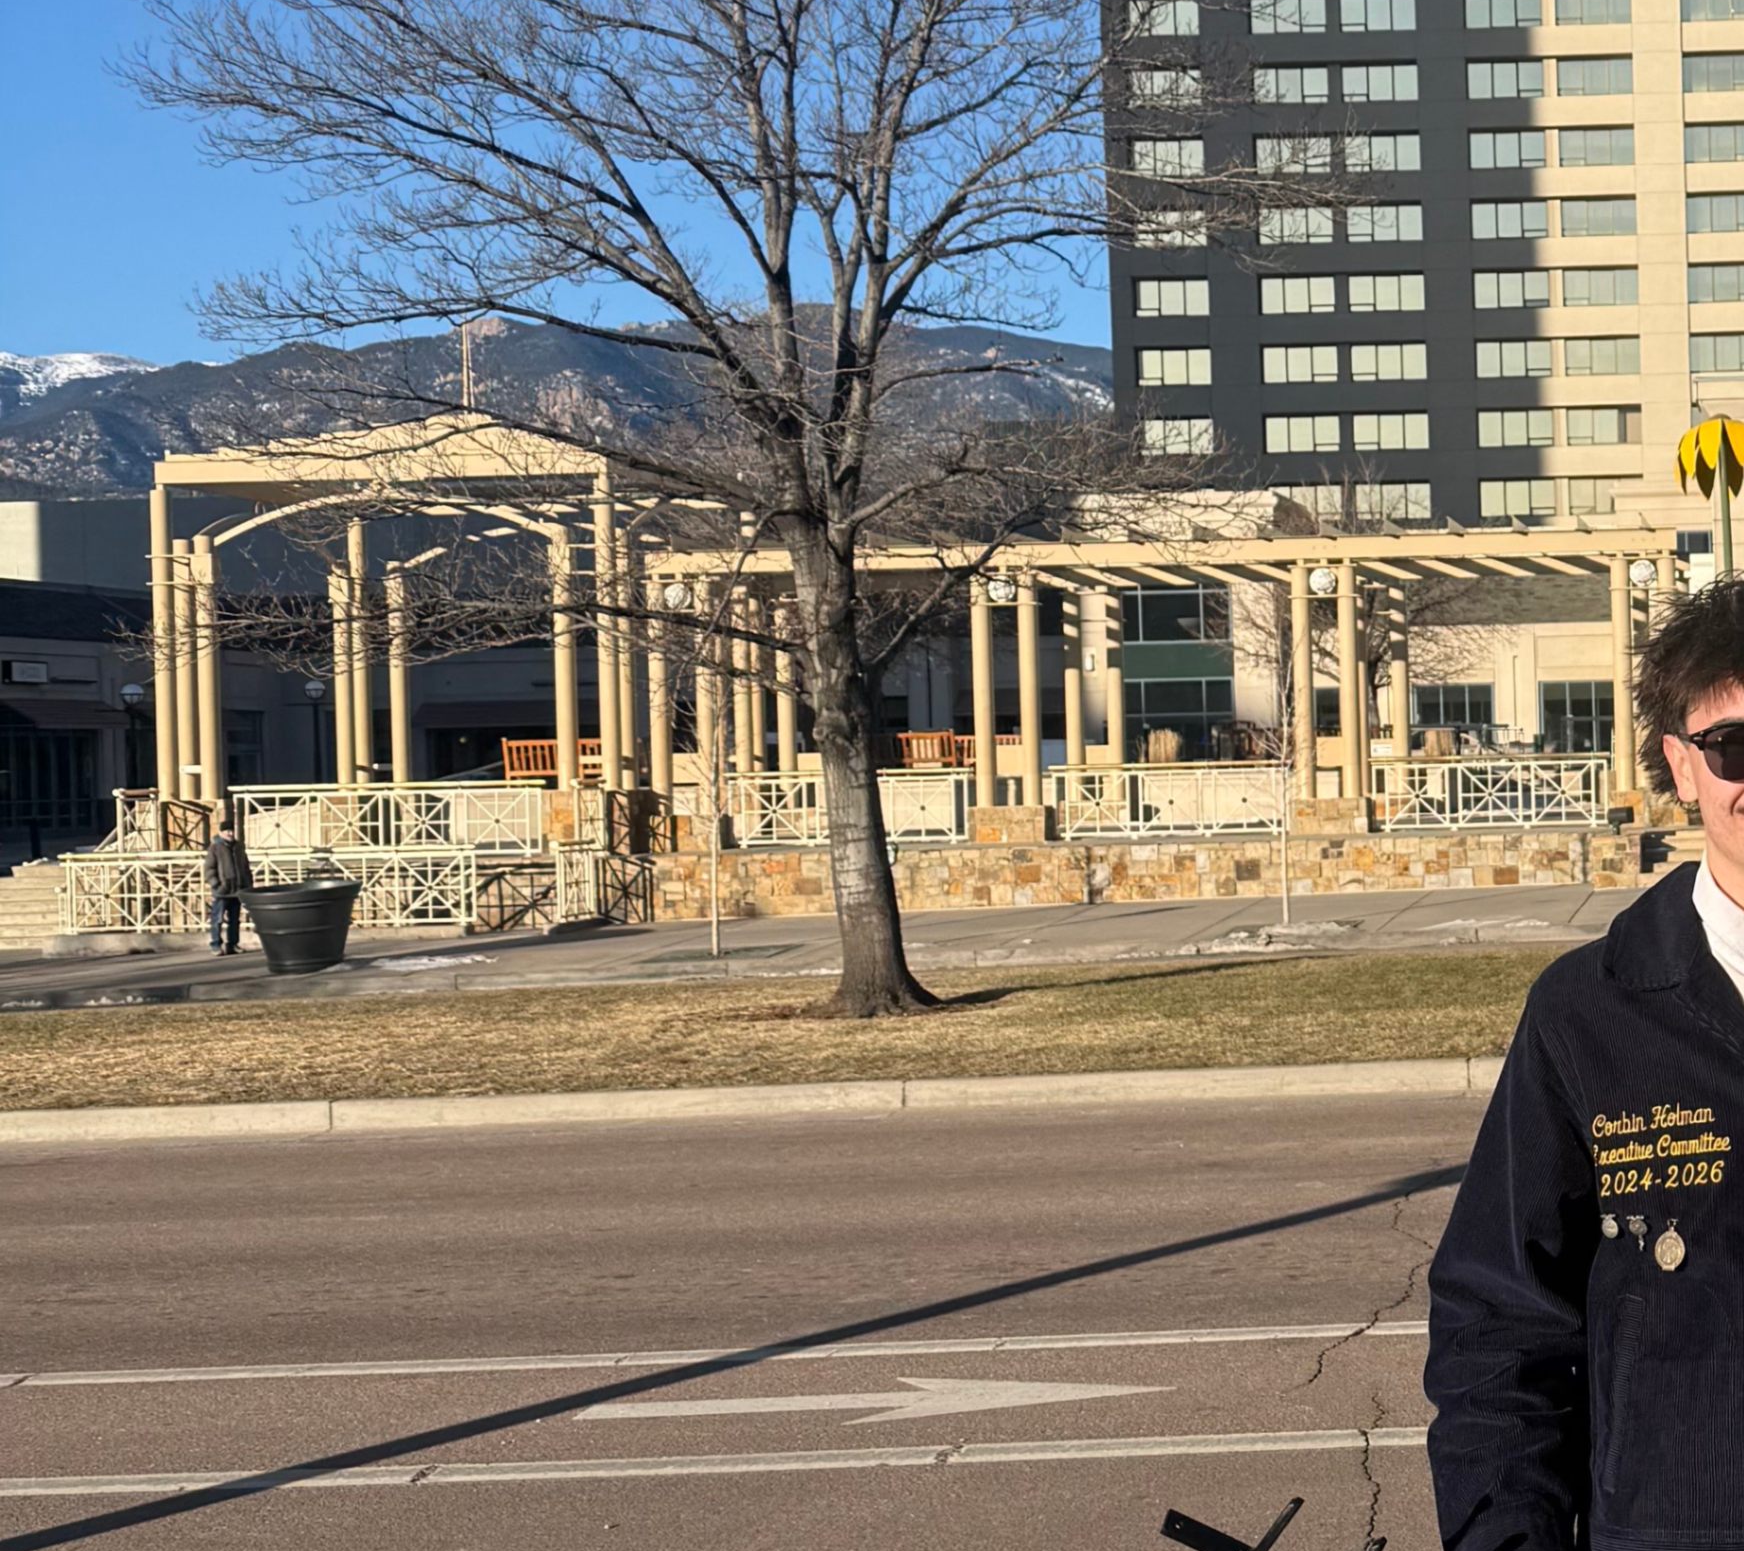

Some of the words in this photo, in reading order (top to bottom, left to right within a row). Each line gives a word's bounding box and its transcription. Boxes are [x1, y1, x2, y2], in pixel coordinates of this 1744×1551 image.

[1592, 1110, 1647, 1138] Corbin
[1650, 1102, 1716, 1130] Holman
[1657, 1131, 1732, 1157] Committee
[1600, 1159, 1725, 1197] 2024-2026
